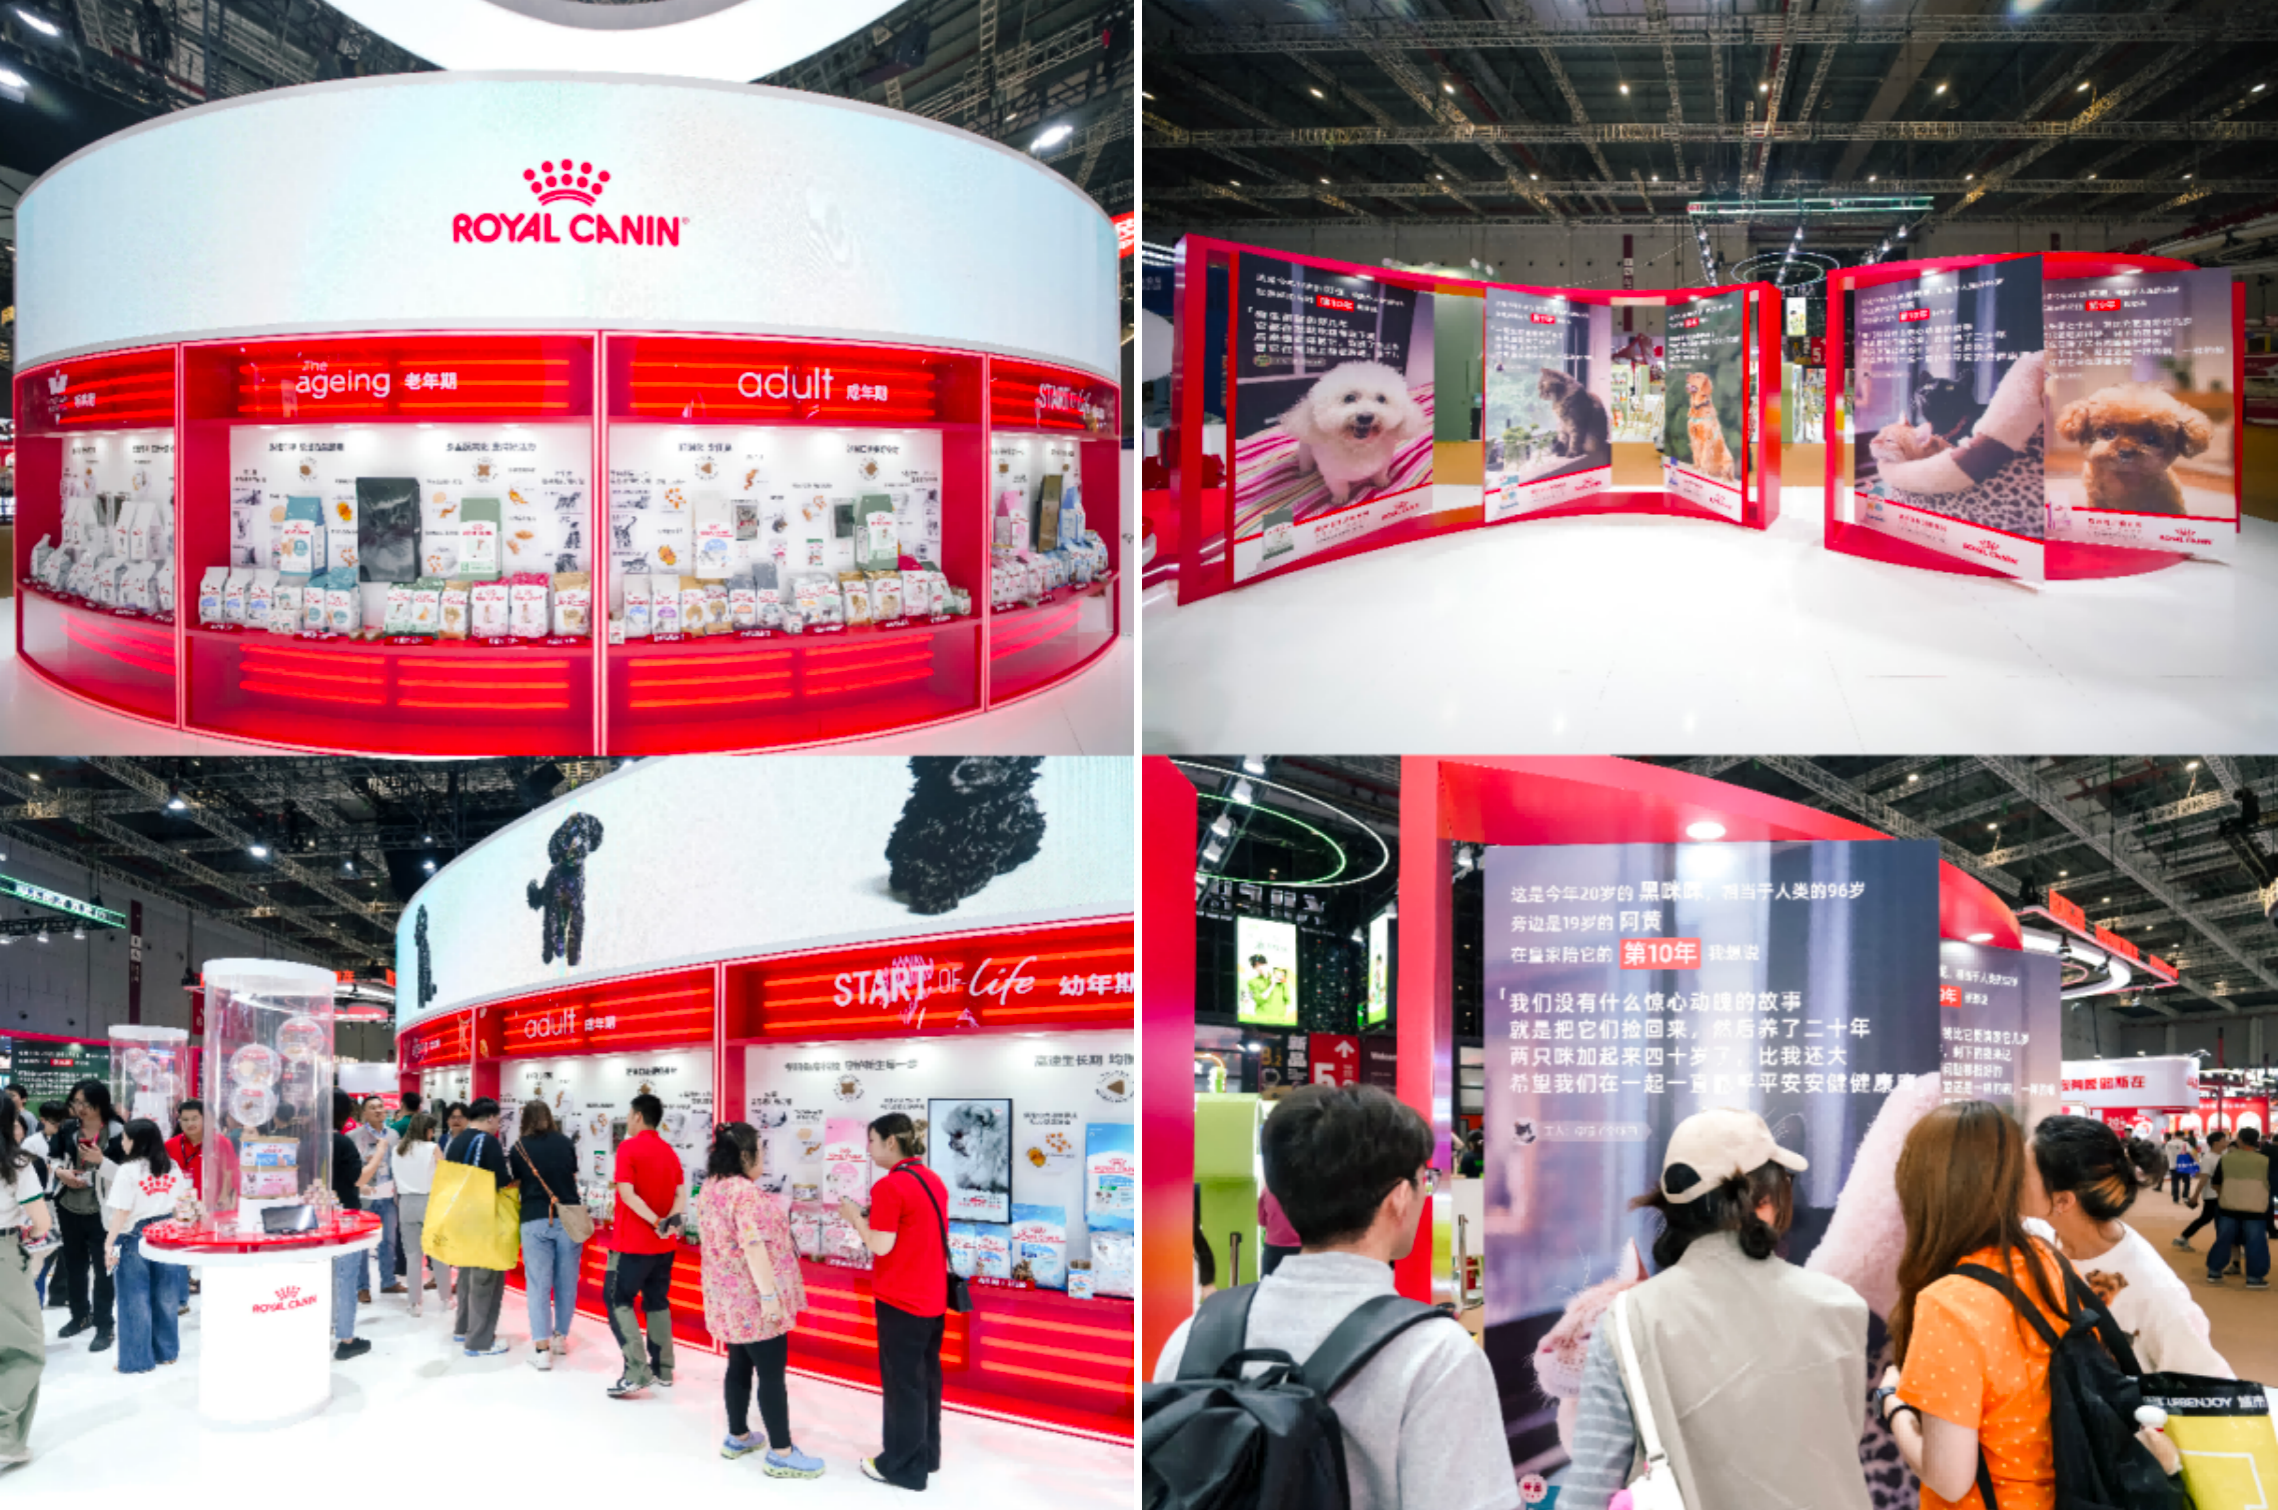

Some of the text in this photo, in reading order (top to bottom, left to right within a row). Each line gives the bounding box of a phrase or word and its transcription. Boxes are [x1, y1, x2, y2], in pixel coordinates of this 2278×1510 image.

[453, 212, 680, 247] ROYAL CANIN
[296, 370, 458, 399] ageing 老年期
[738, 366, 888, 401] adult 成年期
[1510, 885, 1634, 904] 这是今年20岁的
[1510, 911, 1662, 933] 旁边是19岁的 阿黄
[1510, 945, 1613, 964] 在皇家陪它的
[1623, 941, 1698, 967] 第10年
[834, 955, 1134, 1007] START OF life 幼年期
[524, 1006, 576, 1039] adult
[1034, 1054, 1103, 1068] 高速生长期
[252, 1294, 317, 1314] ROYAL CANIN
